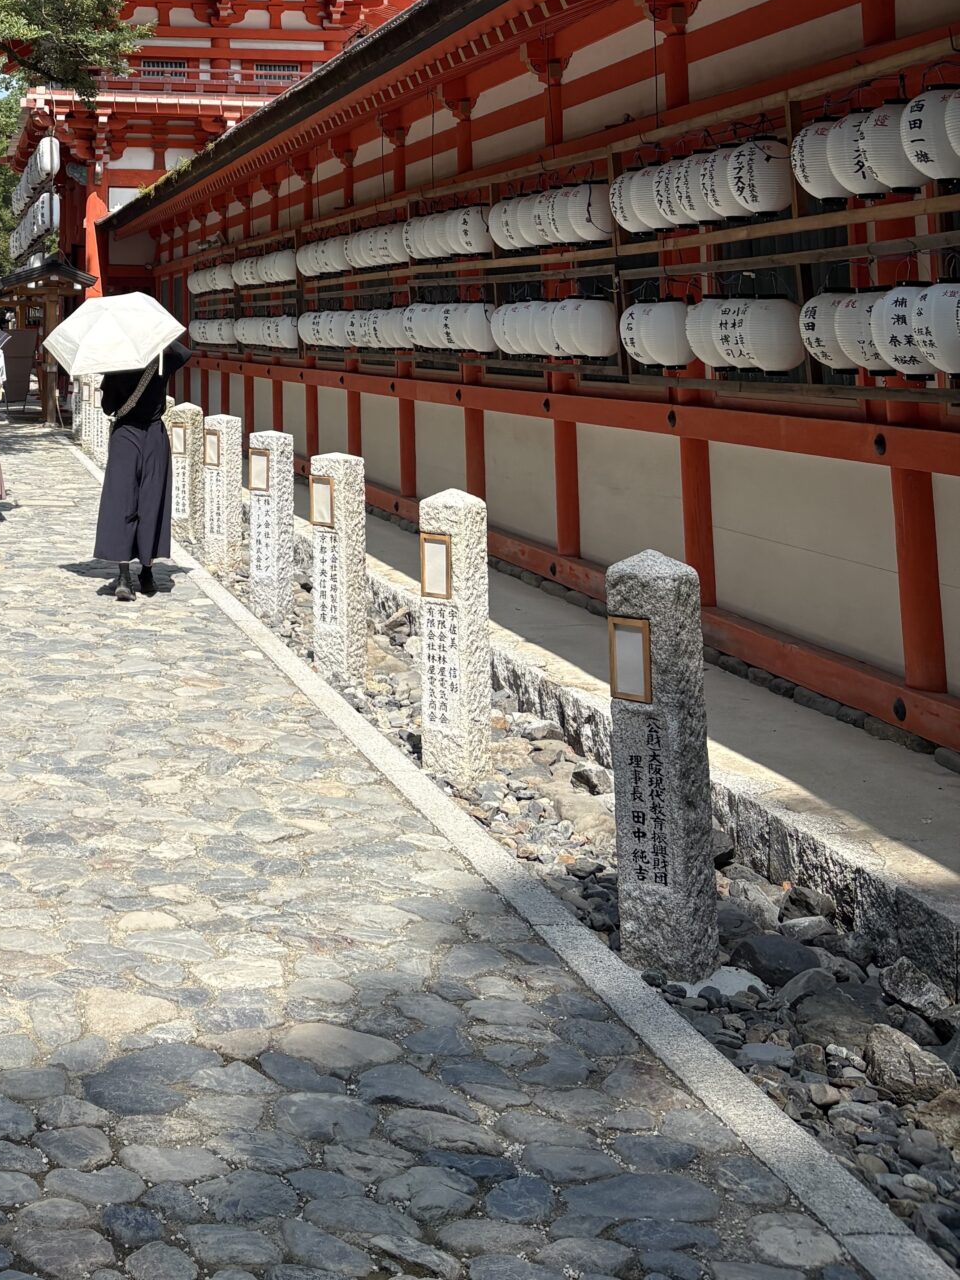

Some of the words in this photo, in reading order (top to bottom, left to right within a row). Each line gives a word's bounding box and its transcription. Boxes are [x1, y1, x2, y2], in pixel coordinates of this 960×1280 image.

[733, 151, 749, 204] チップスター
[319, 534, 328, 622] 京都中央信用金庫
[330, 535, 338, 625] 株式会社堀場製作所
[426, 606, 437, 723] 有限会社林屋電気商会
[437, 607, 449, 724] 有限会社林屋電気商会
